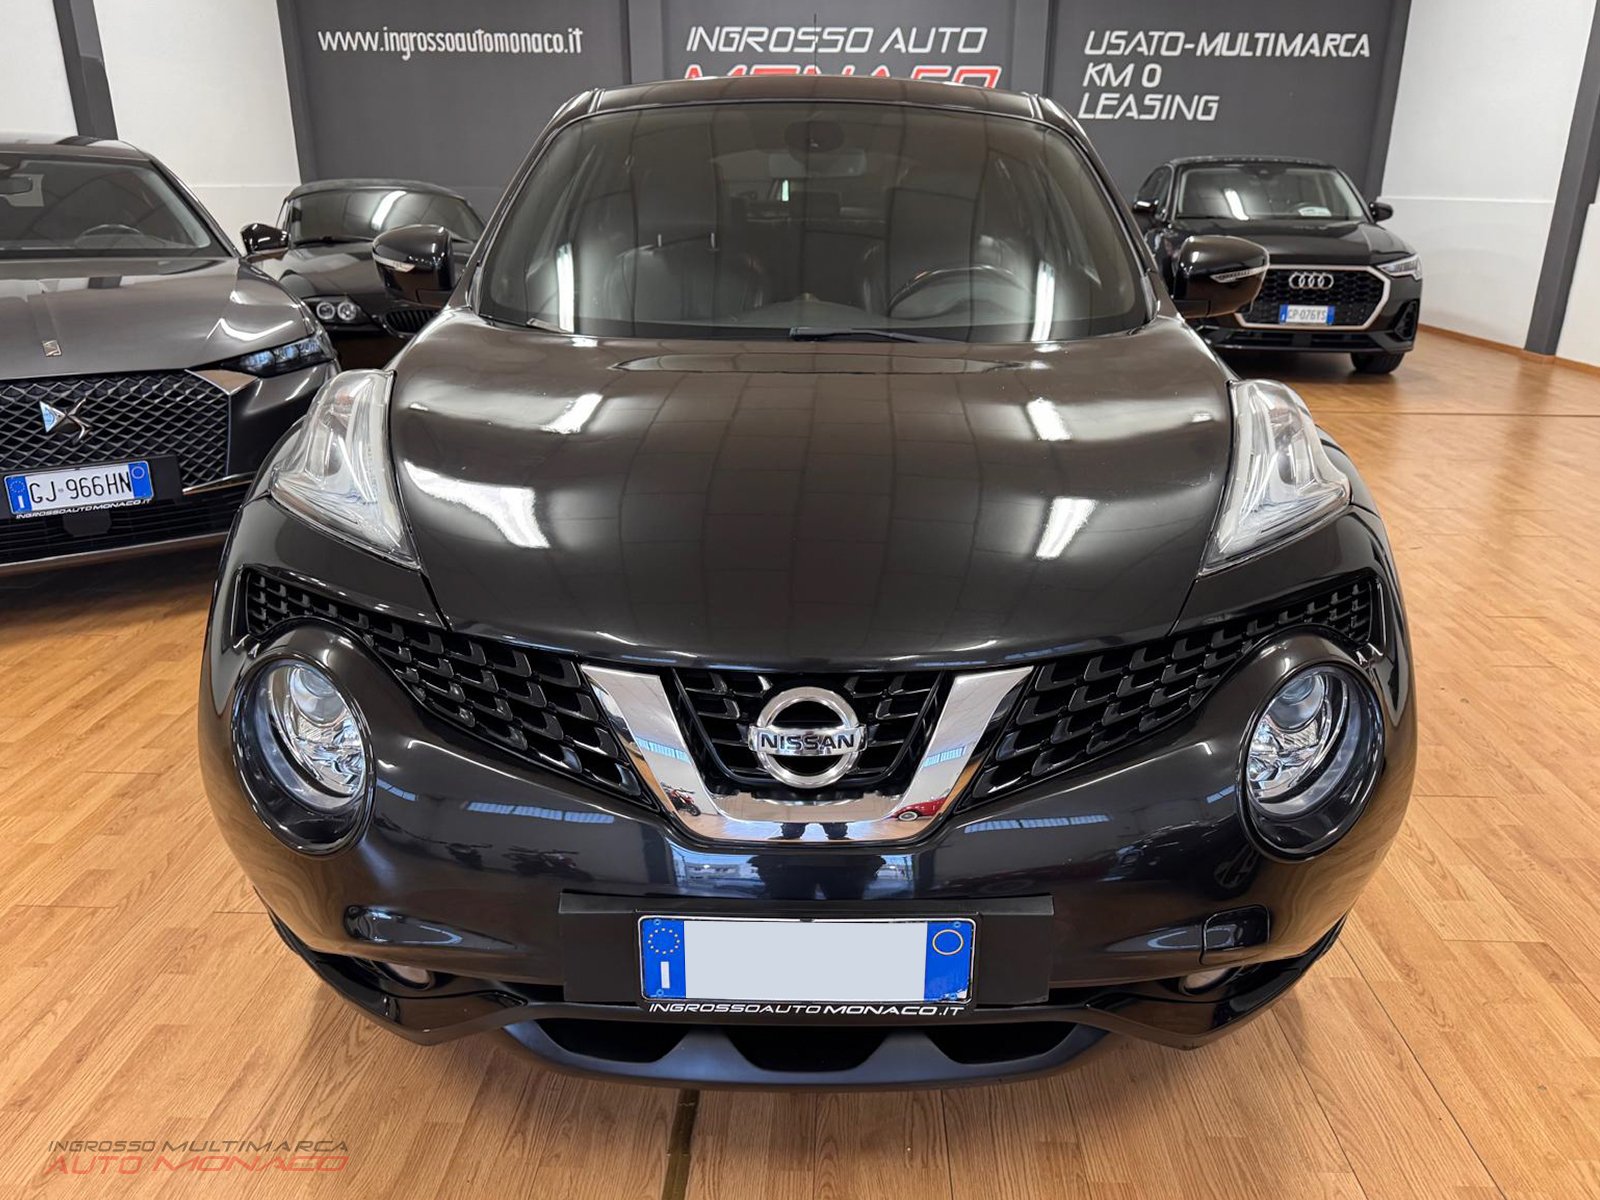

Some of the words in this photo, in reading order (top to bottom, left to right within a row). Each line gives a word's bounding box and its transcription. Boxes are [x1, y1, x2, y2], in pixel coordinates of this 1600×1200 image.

[317, 26, 584, 61] www.ingrossoautomonaco.it
[685, 26, 875, 53] INGROSSO
[879, 26, 989, 54] AUTO
[1083, 30, 1371, 58] USATO-MULTIMARCA
[1082, 62, 1135, 88] KM
[1077, 92, 1220, 121] LEASING
[761, 733, 854, 750] NISSAN
